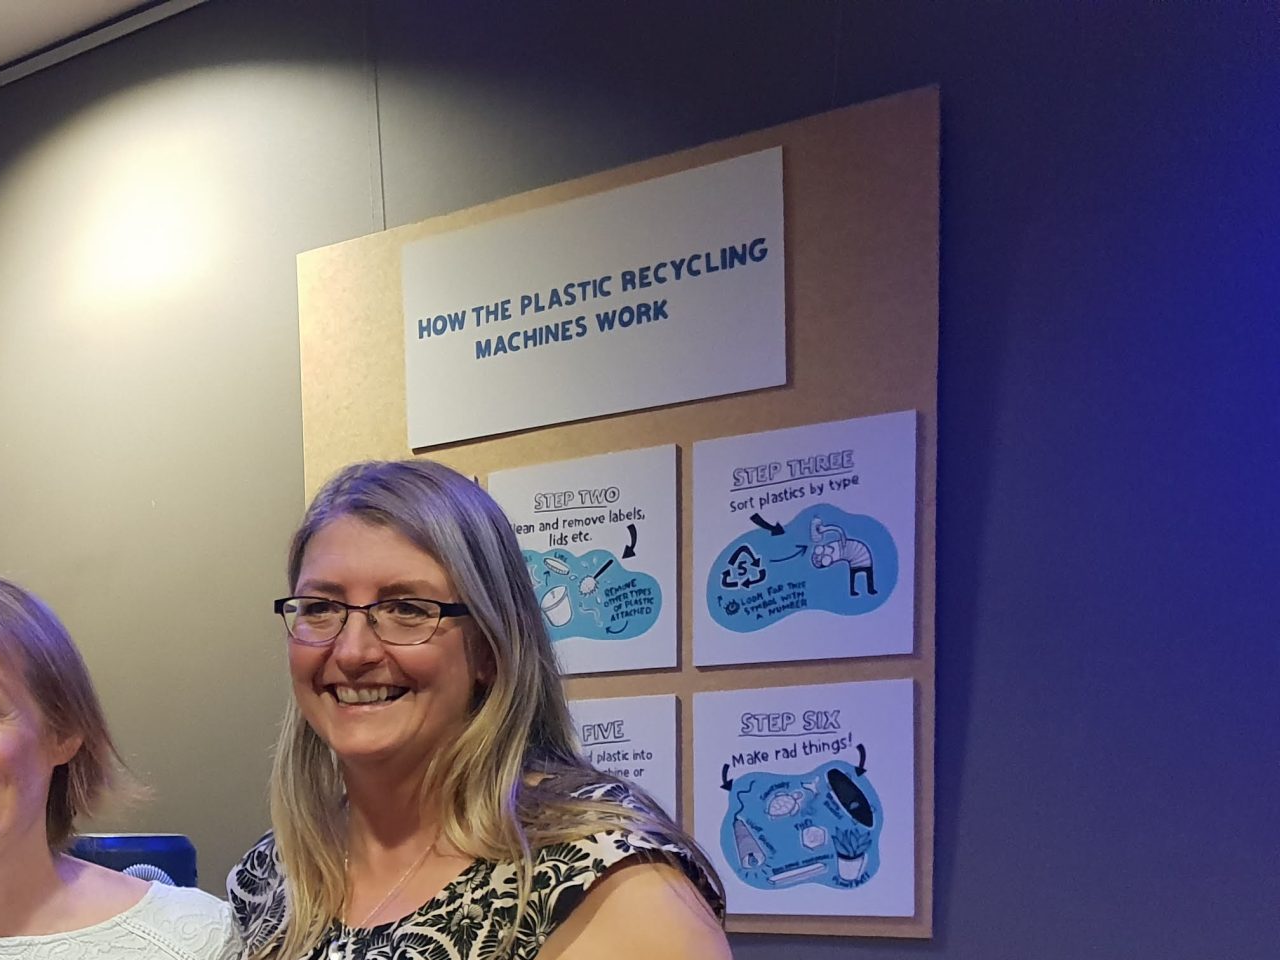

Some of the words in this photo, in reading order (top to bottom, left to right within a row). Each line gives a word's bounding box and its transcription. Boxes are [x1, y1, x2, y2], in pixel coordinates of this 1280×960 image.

[418, 310, 467, 339] HOW
[472, 299, 511, 327] THE
[520, 276, 612, 315] PLASTIC
[622, 238, 768, 292] RECYCLING
[475, 316, 587, 359] MACHINES
[596, 300, 669, 332] WORK
[733, 462, 782, 487] STEP
[787, 450, 854, 477] THREE
[534, 491, 574, 510] STEP
[578, 486, 620, 505] TWO
[730, 497, 754, 512] Sort
[759, 486, 805, 509] plastics
[810, 483, 824, 496] by
[829, 475, 859, 491] type
[512, 524, 535, 535] lean
[538, 518, 559, 532] and
[562, 514, 606, 530] remove
[609, 507, 646, 523] labels,
[549, 534, 568, 546] lids
[572, 531, 592, 542] etc.
[738, 560, 748, 576] 5
[604, 579, 637, 597] REMOVE
[604, 594, 629, 608] OTHER
[630, 588, 652, 598] TYPES
[767, 585, 784, 596] FOR
[625, 597, 654, 609] PLASTIC
[610, 608, 652, 622] ATTACHED
[582, 720, 624, 742] FIVE
[741, 712, 796, 734] STEP
[802, 710, 841, 730] SIX
[597, 750, 629, 764] plastic
[633, 749, 652, 760] into
[732, 750, 768, 768] Make
[775, 743, 797, 760] rad
[802, 732, 852, 756] things!
[634, 769, 645, 777] or
